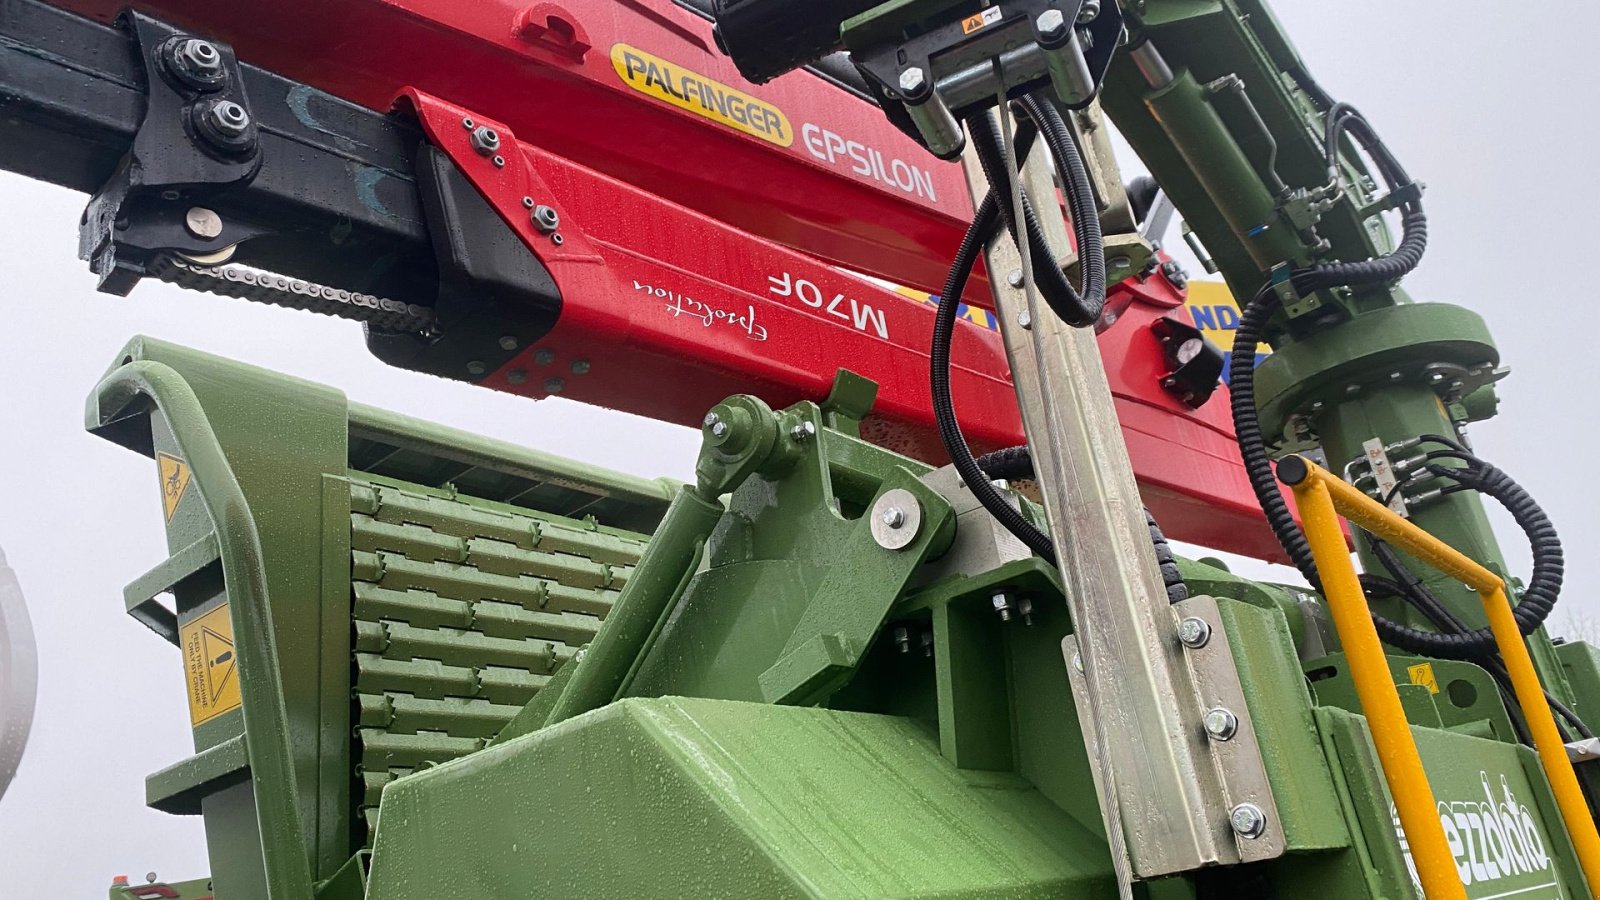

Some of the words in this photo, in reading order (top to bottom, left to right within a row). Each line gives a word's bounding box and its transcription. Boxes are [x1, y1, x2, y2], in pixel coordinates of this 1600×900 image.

[622, 51, 786, 140] PALFINGER
[802, 122, 937, 203] EPSILON
[633, 279, 768, 341] Epsolution
[192, 632, 200, 653] FEED
[198, 670, 208, 709] MACHINE
[192, 677, 201, 705] CRANE
[1391, 771, 1548, 886] ezzolato
